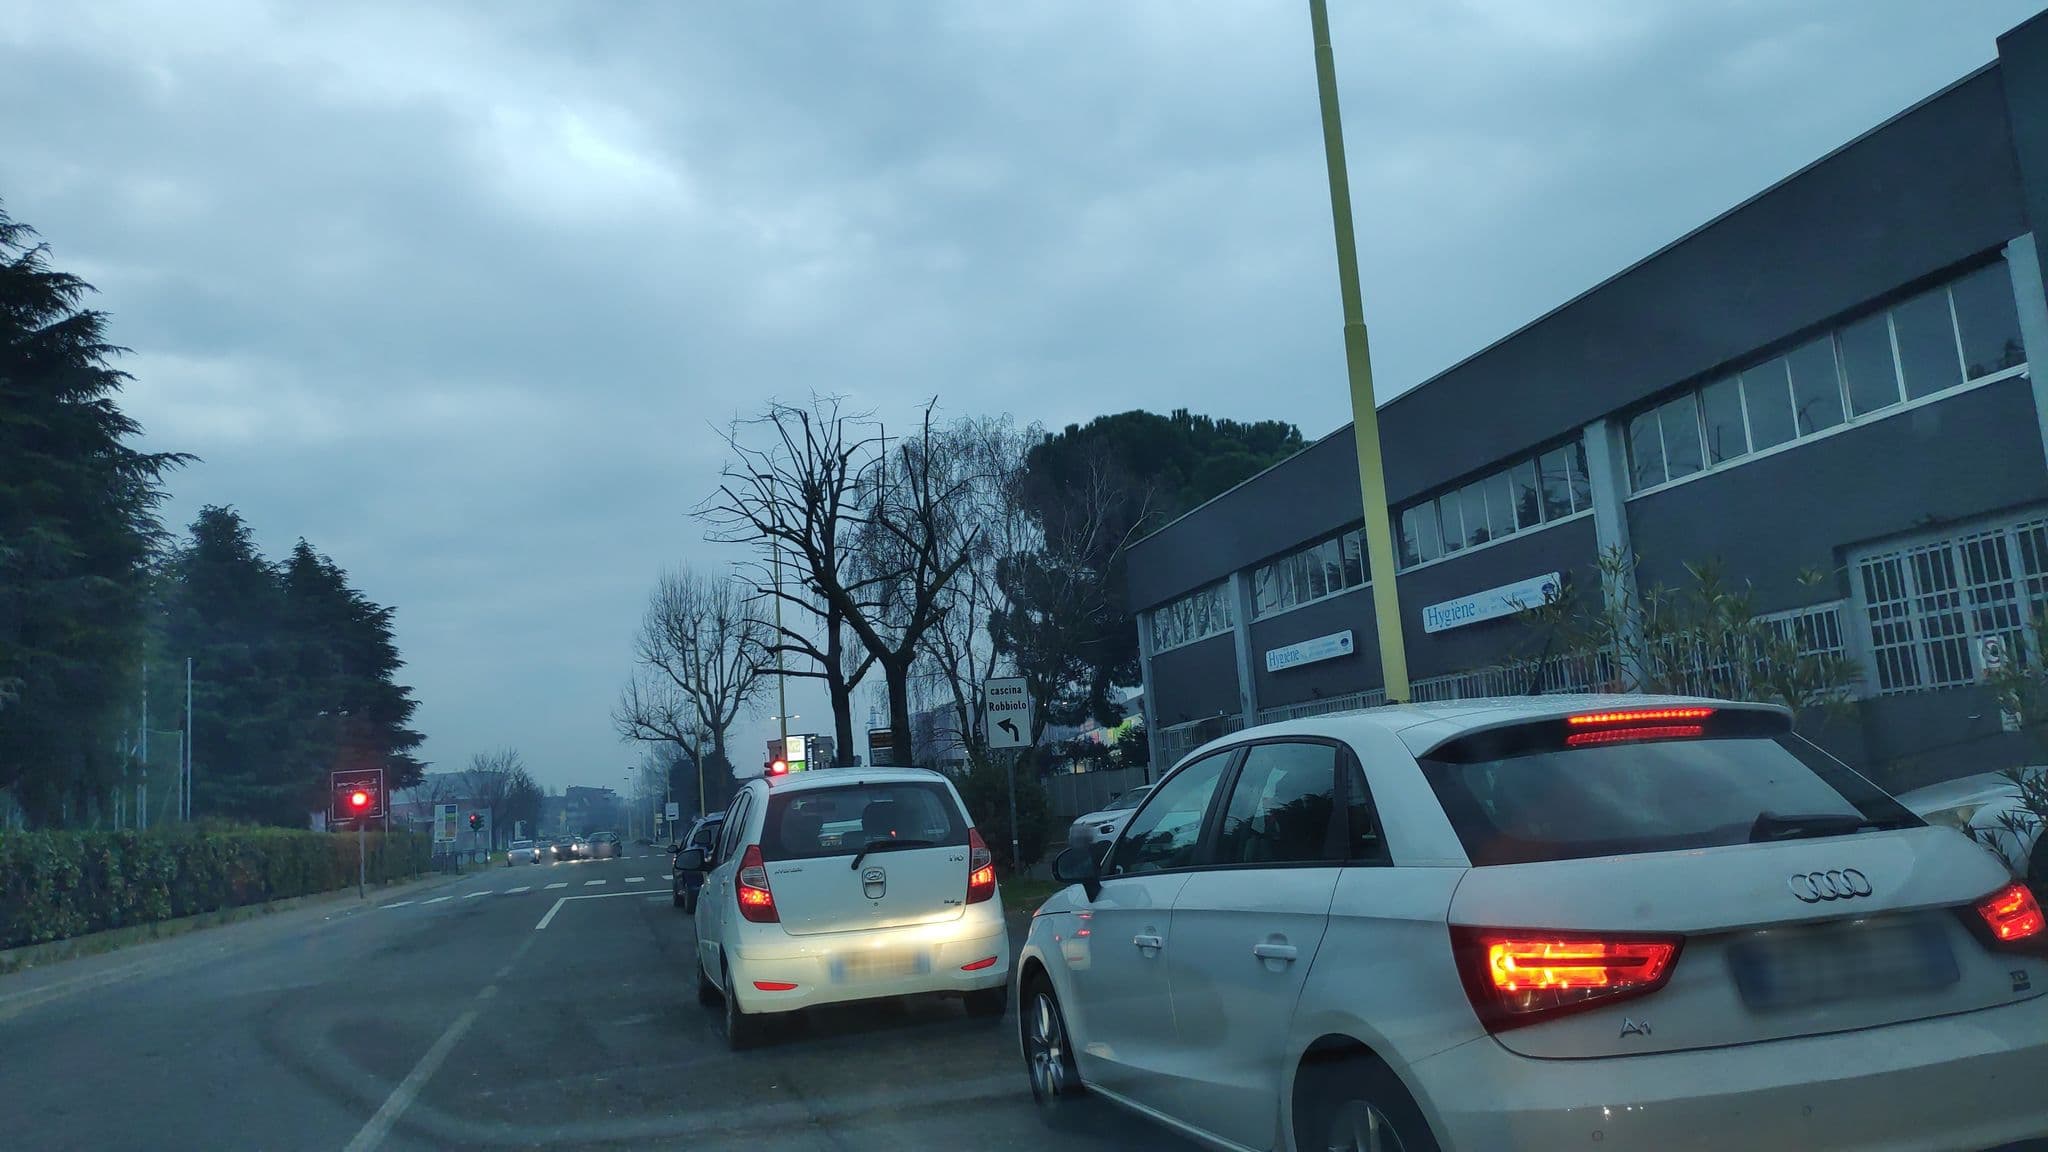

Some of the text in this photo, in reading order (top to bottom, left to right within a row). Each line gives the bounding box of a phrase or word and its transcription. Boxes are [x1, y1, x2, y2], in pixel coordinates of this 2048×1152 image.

[990, 685, 1022, 696] cascina
[988, 700, 1027, 712] Robbiolo
[1620, 1015, 1652, 1038] A1
